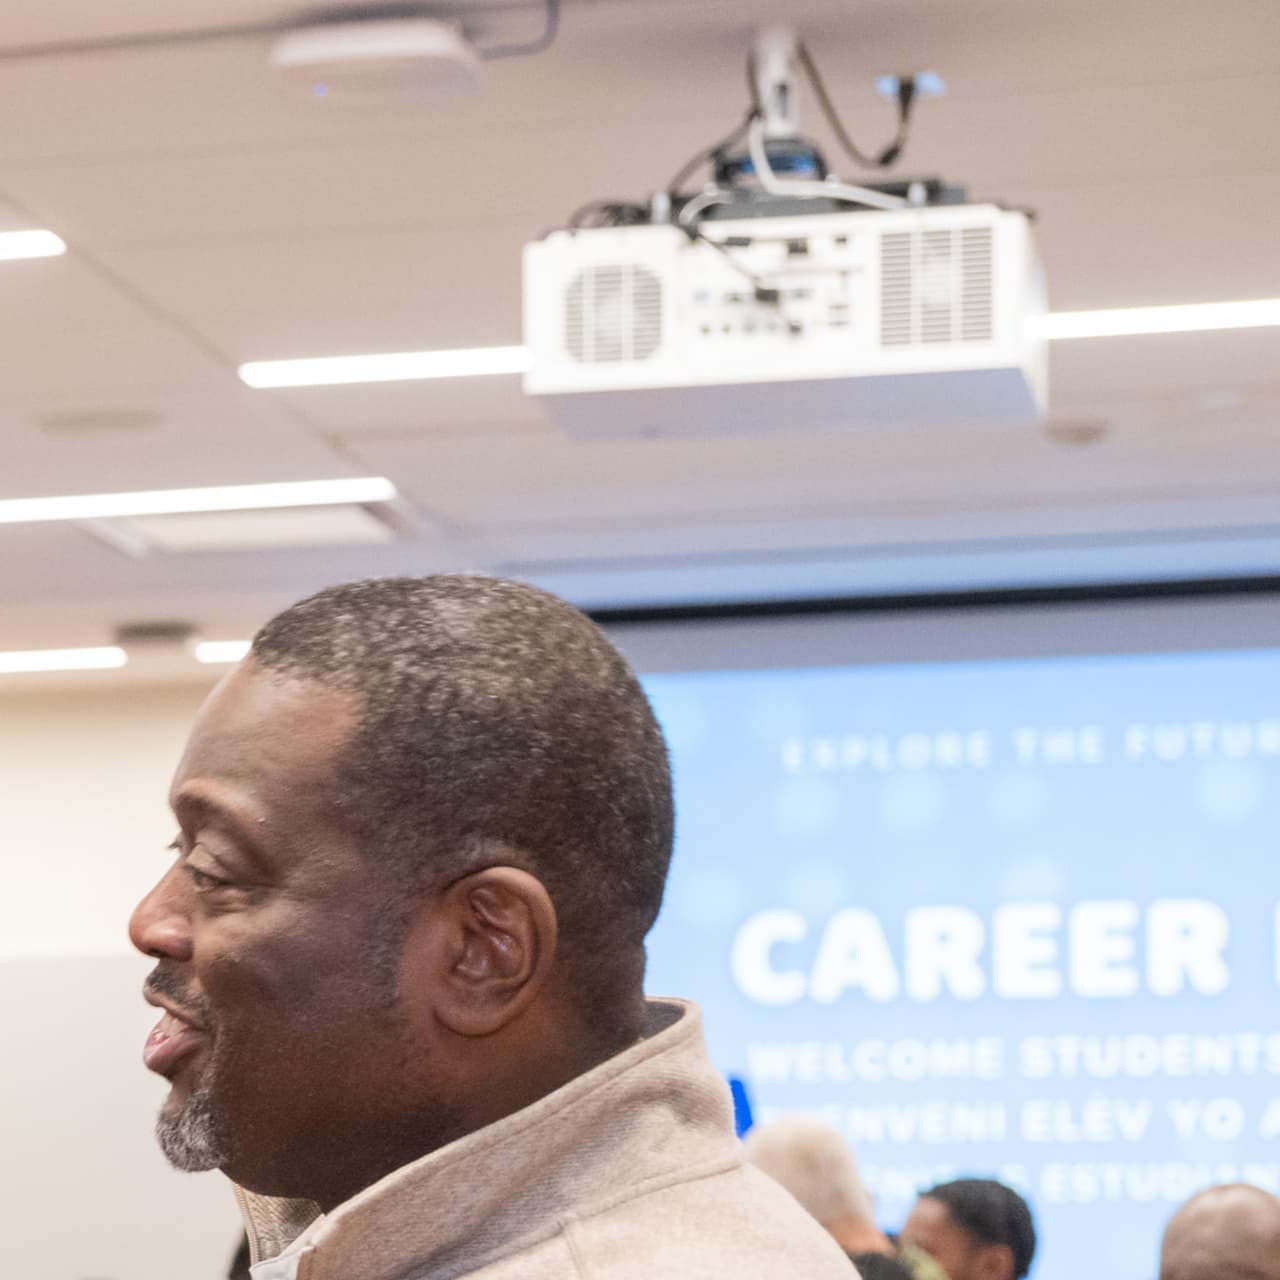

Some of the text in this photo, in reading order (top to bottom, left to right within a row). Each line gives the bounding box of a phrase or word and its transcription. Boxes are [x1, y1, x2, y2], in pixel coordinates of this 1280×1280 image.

[781, 729, 993, 774] EXPLORE
[1011, 723, 1104, 764] THE
[731, 898, 1230, 1004] CAREER
[746, 1037, 1004, 1083] WELCOME
